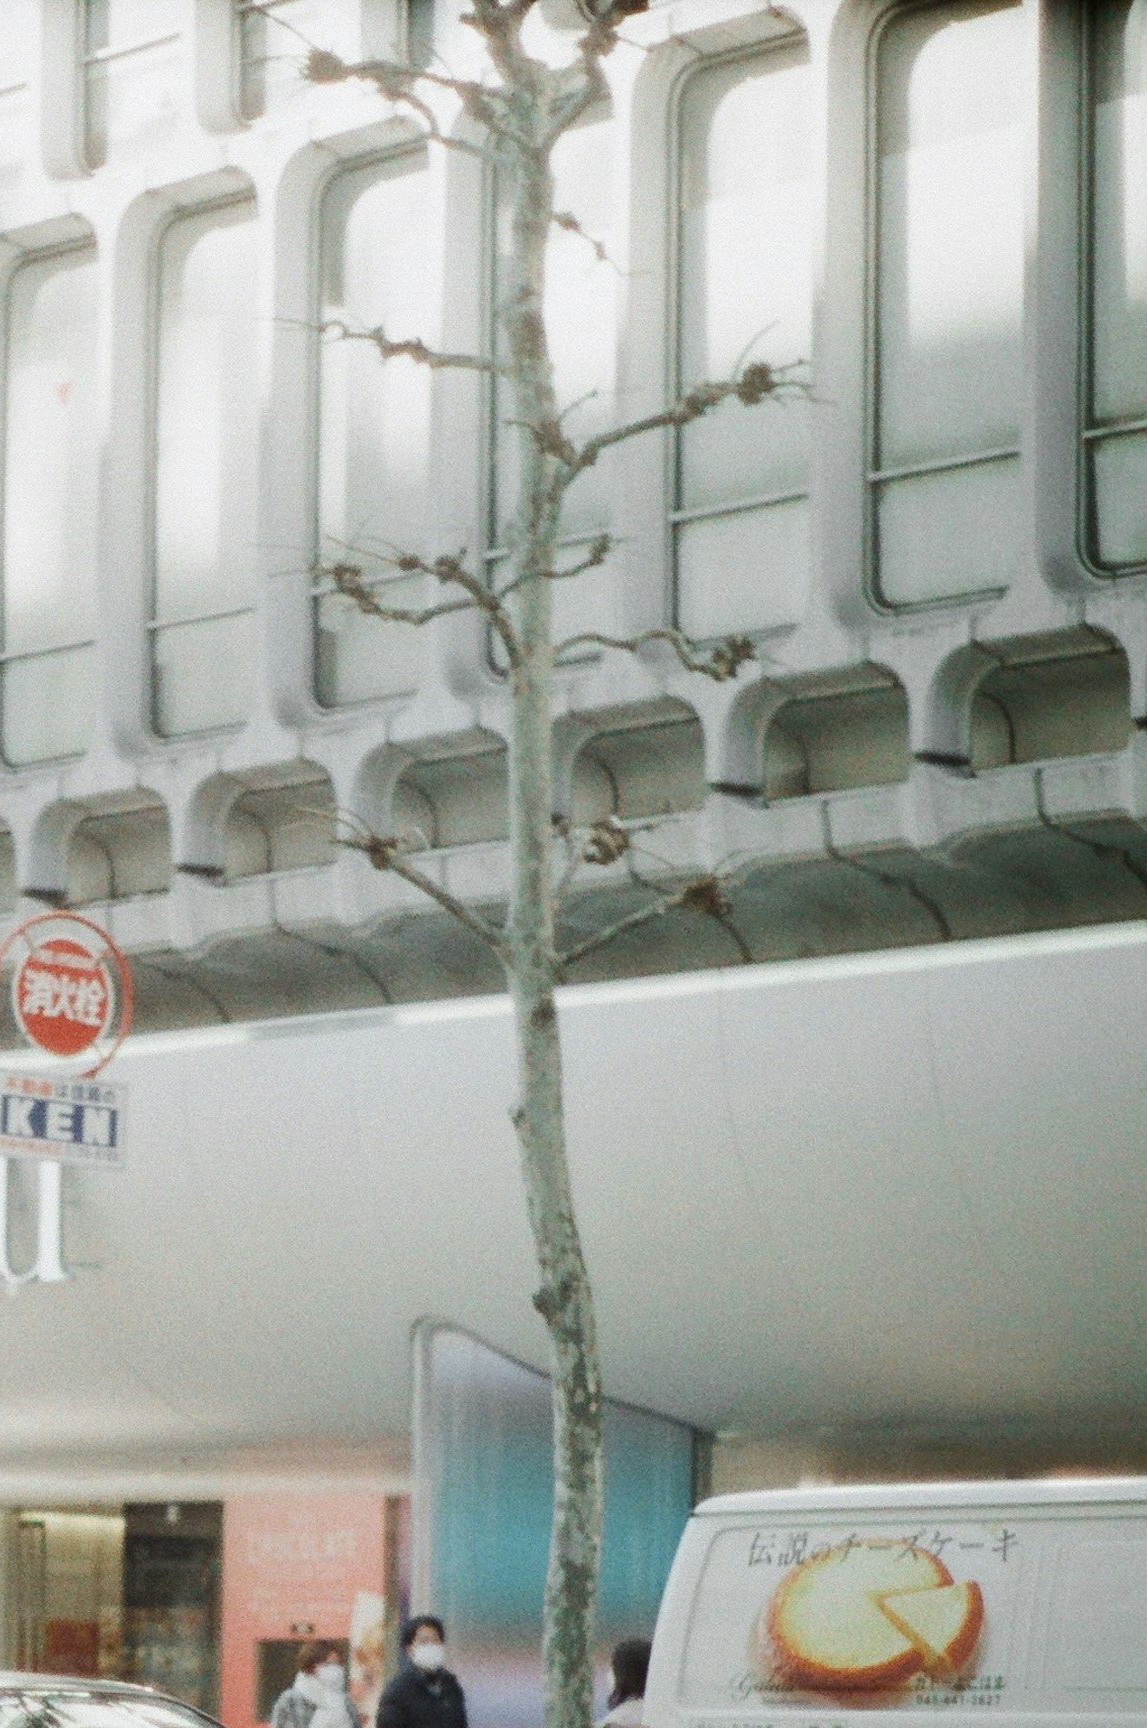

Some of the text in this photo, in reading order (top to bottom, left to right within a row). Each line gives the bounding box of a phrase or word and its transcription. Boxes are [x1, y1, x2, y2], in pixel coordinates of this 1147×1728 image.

[22, 968, 106, 1027] 消火栓
[8, 1095, 112, 1146] KEN
[747, 1528, 1019, 1567] 伝説のチーズケーキ
